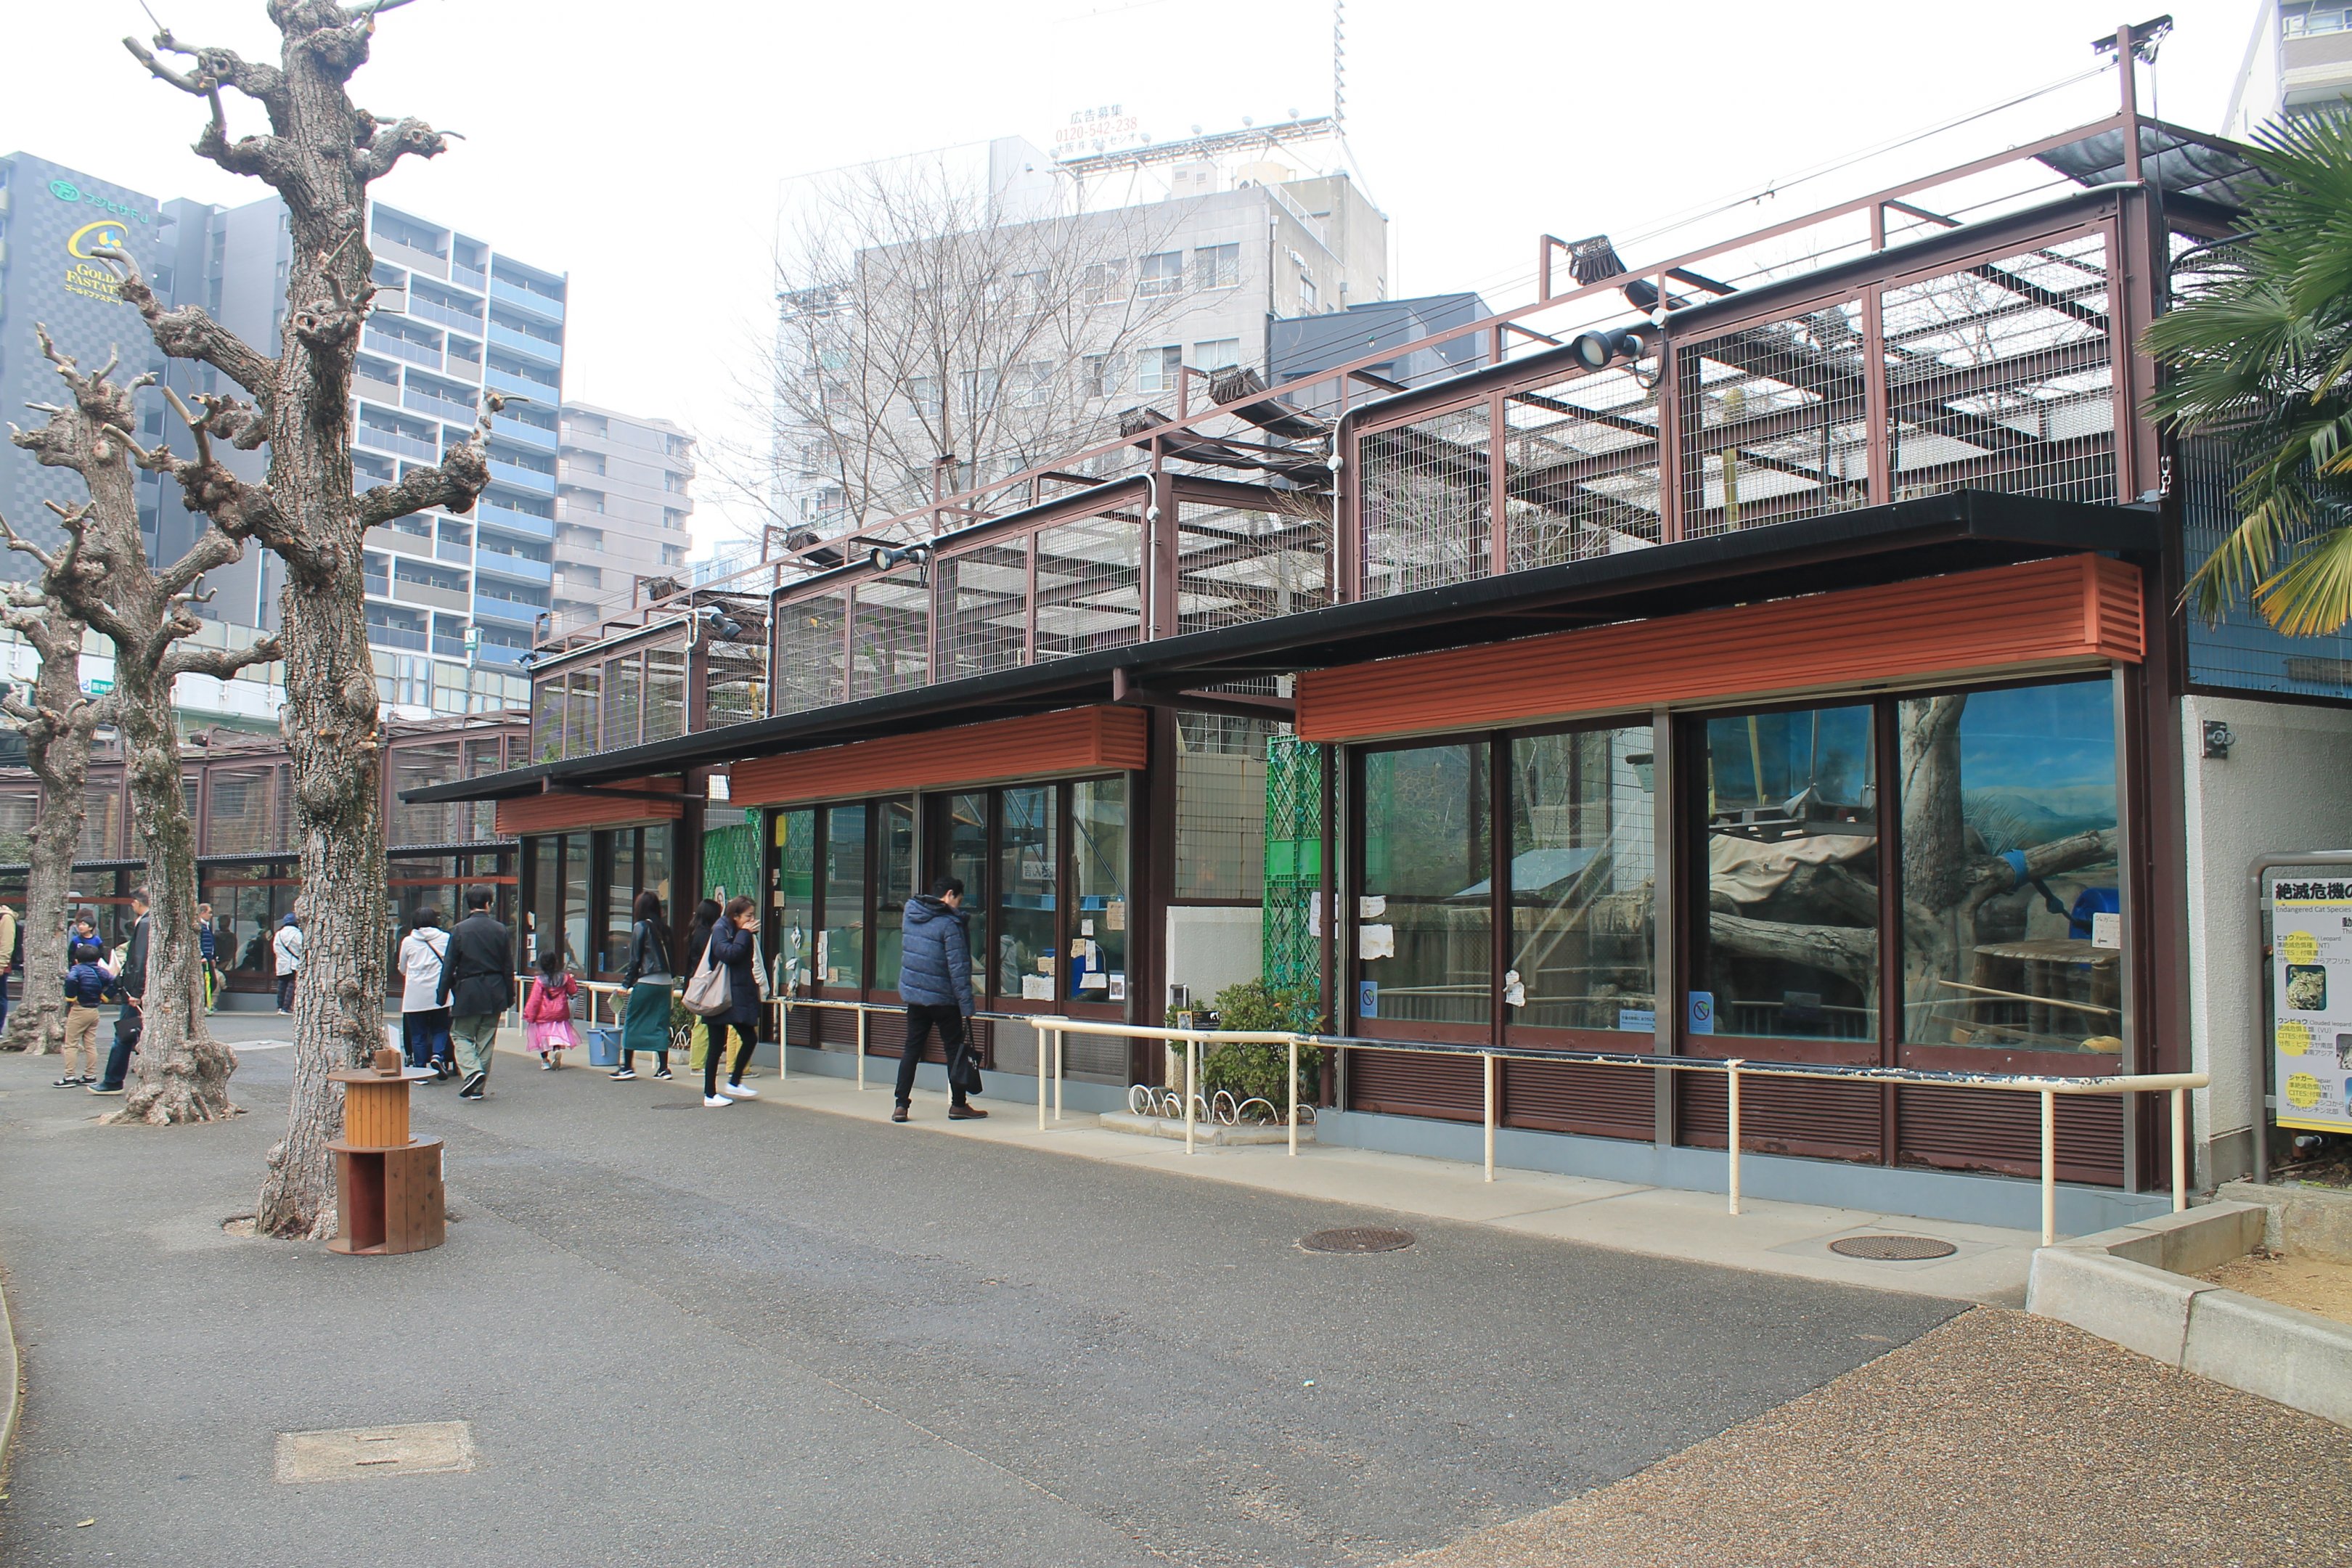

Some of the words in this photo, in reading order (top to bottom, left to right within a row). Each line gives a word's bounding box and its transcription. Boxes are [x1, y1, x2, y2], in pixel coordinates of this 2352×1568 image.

[1070, 105, 1123, 125] 広告募集
[1055, 117, 1138, 142] 0120-542-238
[65, 269, 121, 296] FASTAT
[75, 264, 115, 284] GOLD
[64, 284, 123, 306] ゴールドファステート
